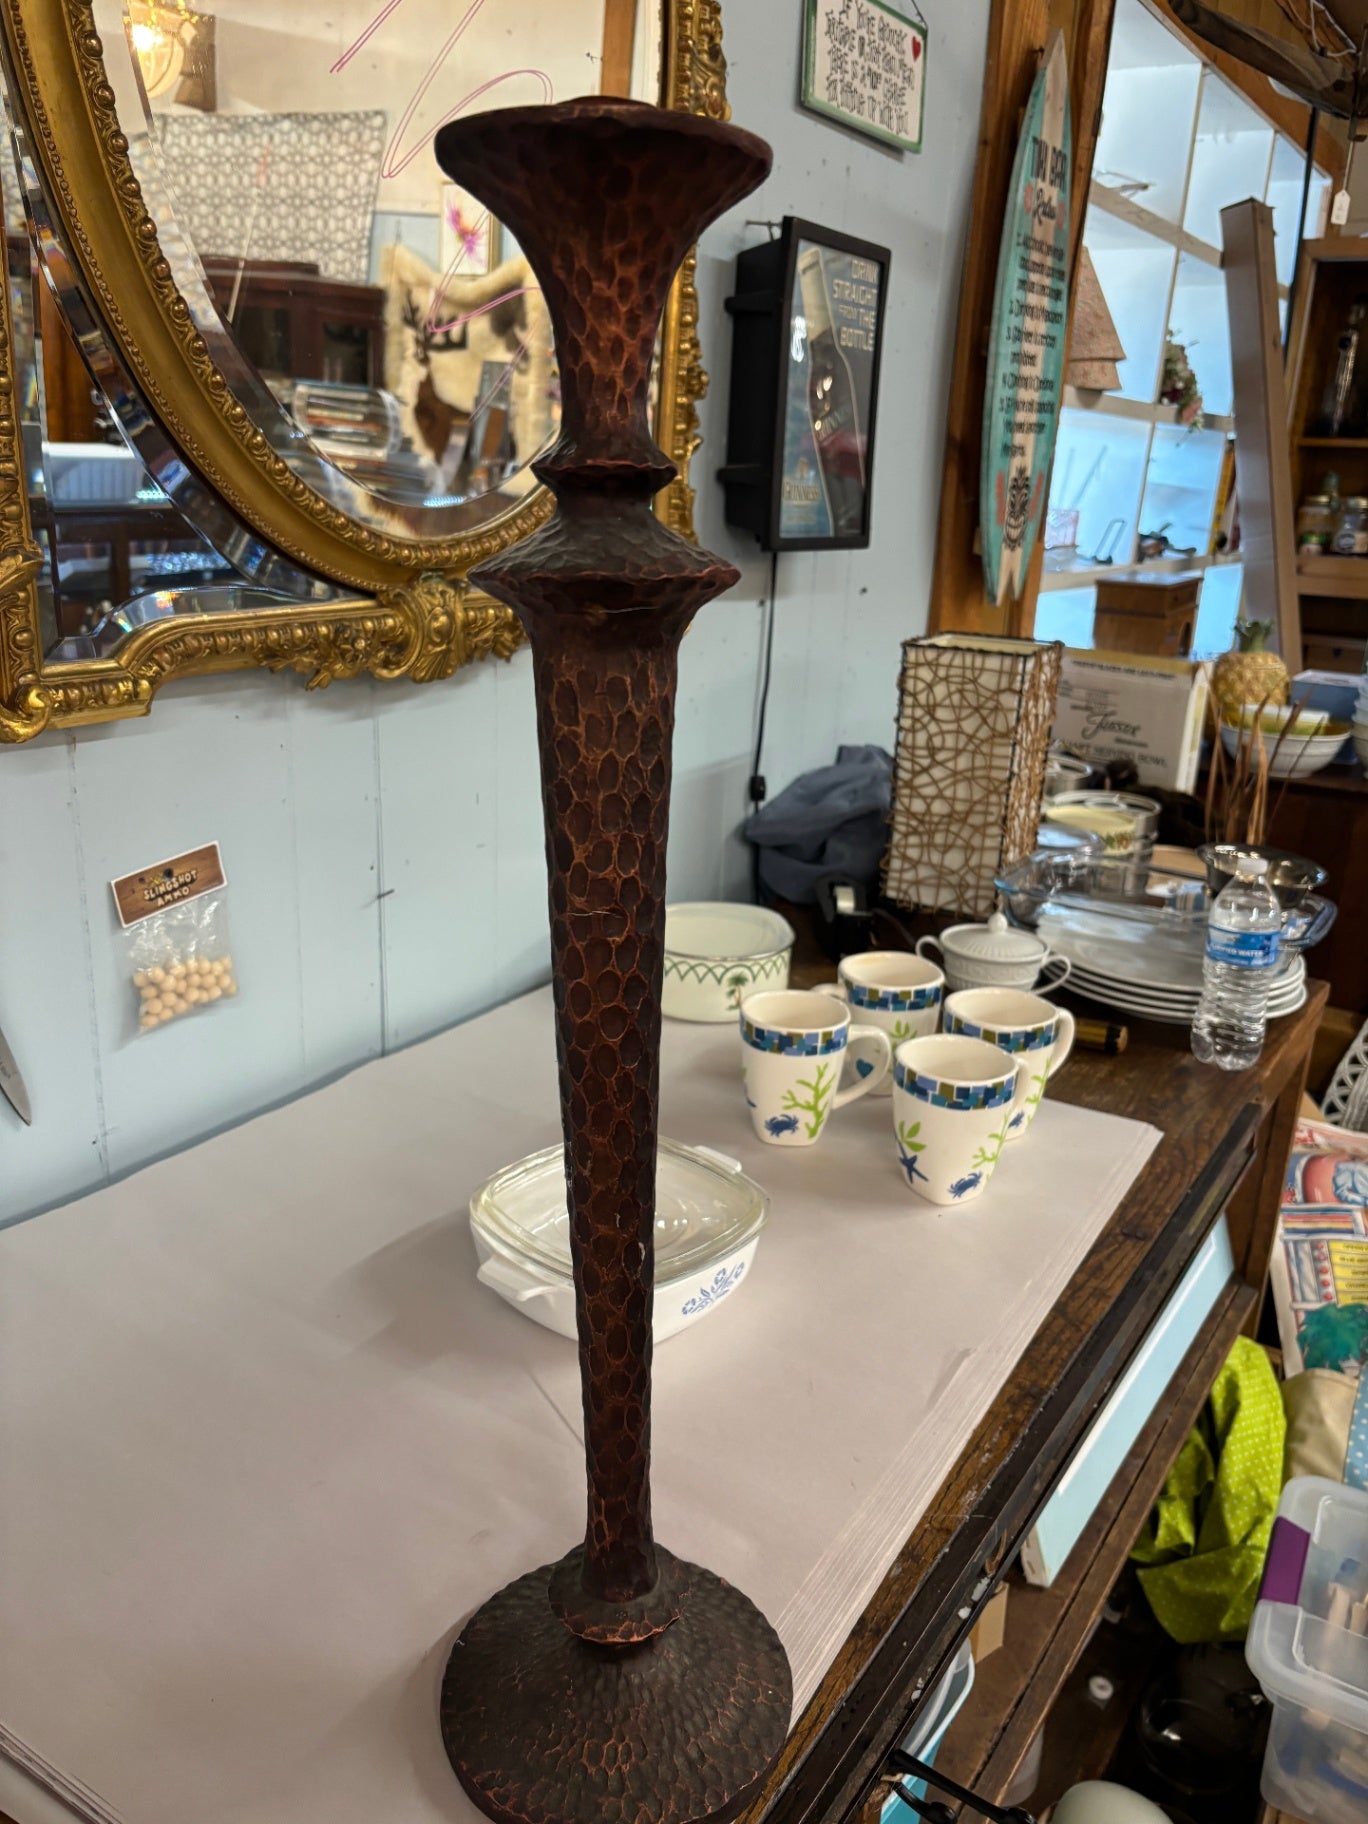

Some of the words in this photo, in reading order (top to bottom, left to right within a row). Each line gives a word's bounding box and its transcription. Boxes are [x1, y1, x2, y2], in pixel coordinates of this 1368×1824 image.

[851, 258, 879, 283] DRINK
[832, 278, 877, 307] STRAIGHT
[839, 305, 858, 320] FROM
[859, 308, 876, 331] THE
[840, 327, 874, 352] BOTTLE
[143, 870, 198, 900] SLINGSHOT
[157, 886, 190, 907] AMMO
